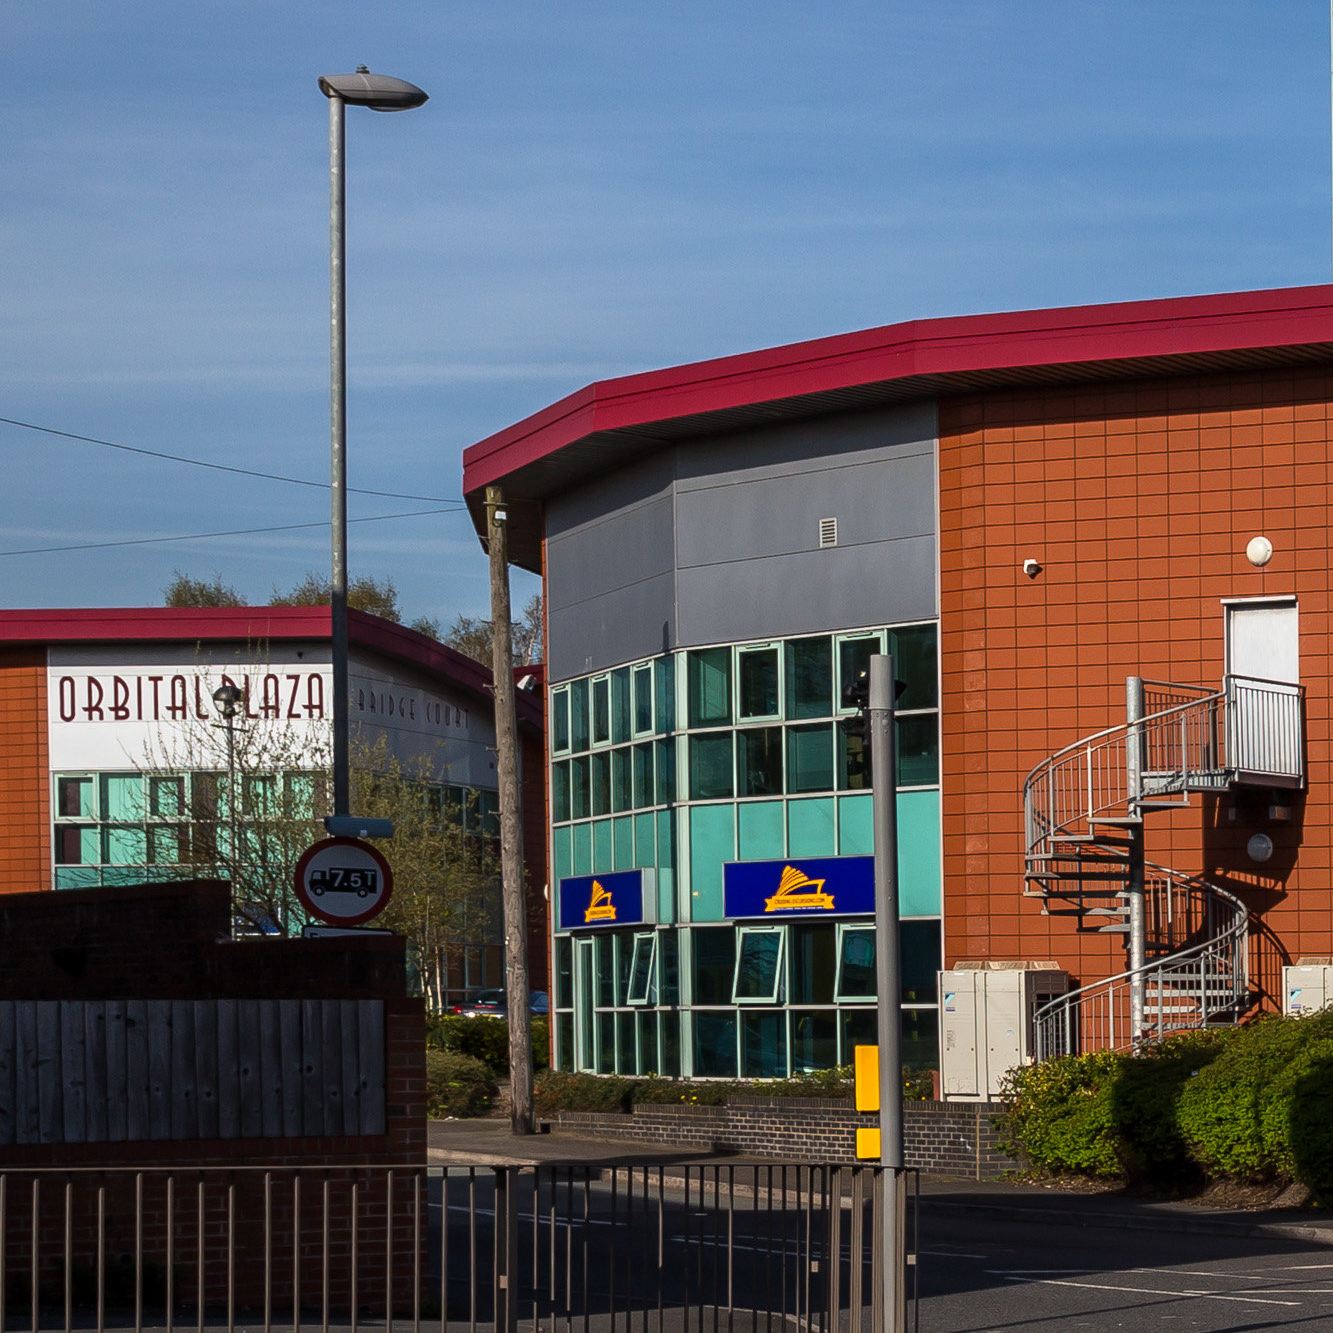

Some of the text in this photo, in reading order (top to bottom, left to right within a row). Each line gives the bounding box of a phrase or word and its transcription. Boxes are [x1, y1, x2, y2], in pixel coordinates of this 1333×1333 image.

[59, 674, 209, 723] ORBITAL
[358, 688, 469, 729] BRIDGE COURT
